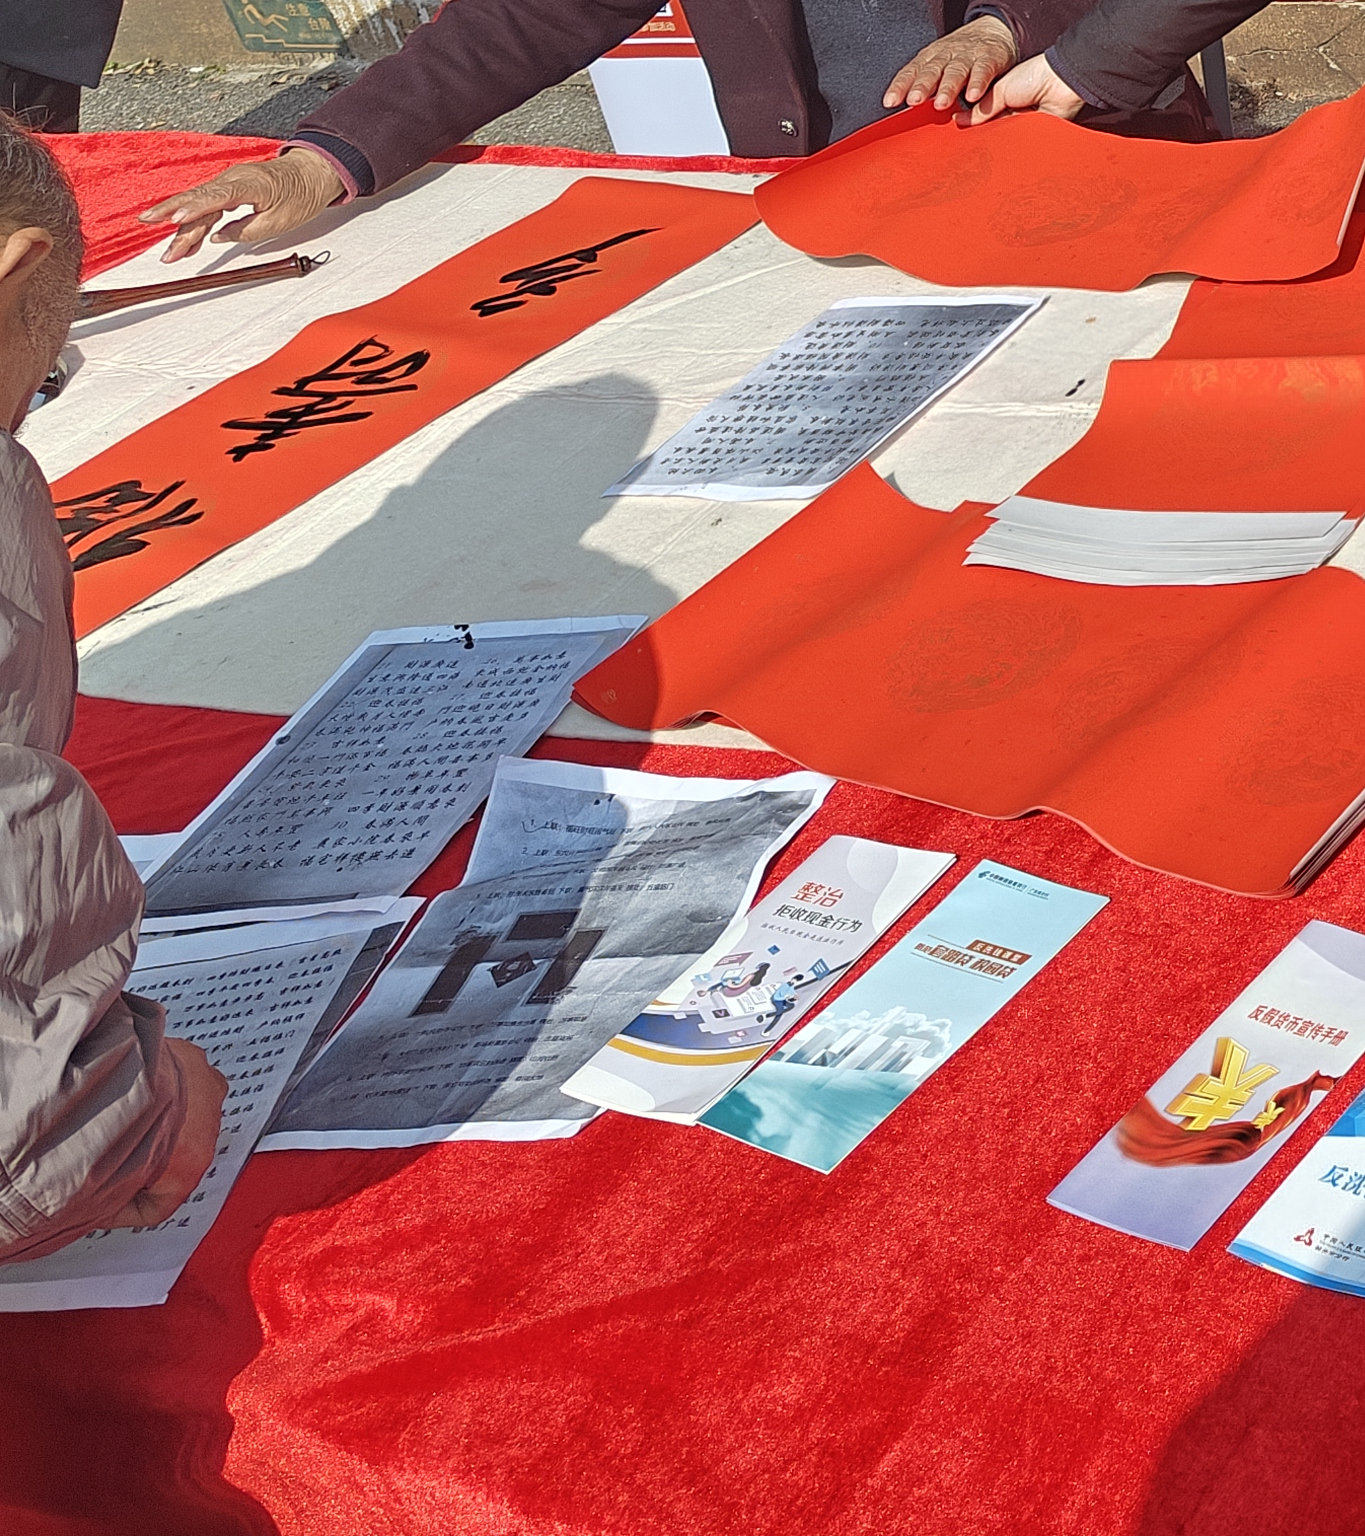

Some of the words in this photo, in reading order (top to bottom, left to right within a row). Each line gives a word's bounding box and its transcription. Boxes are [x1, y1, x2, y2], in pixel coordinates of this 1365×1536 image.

[789, 880, 845, 908] 整治
[771, 904, 863, 934] 拒收现金行为
[1247, 1004, 1349, 1048] 反假货币宣传手册
